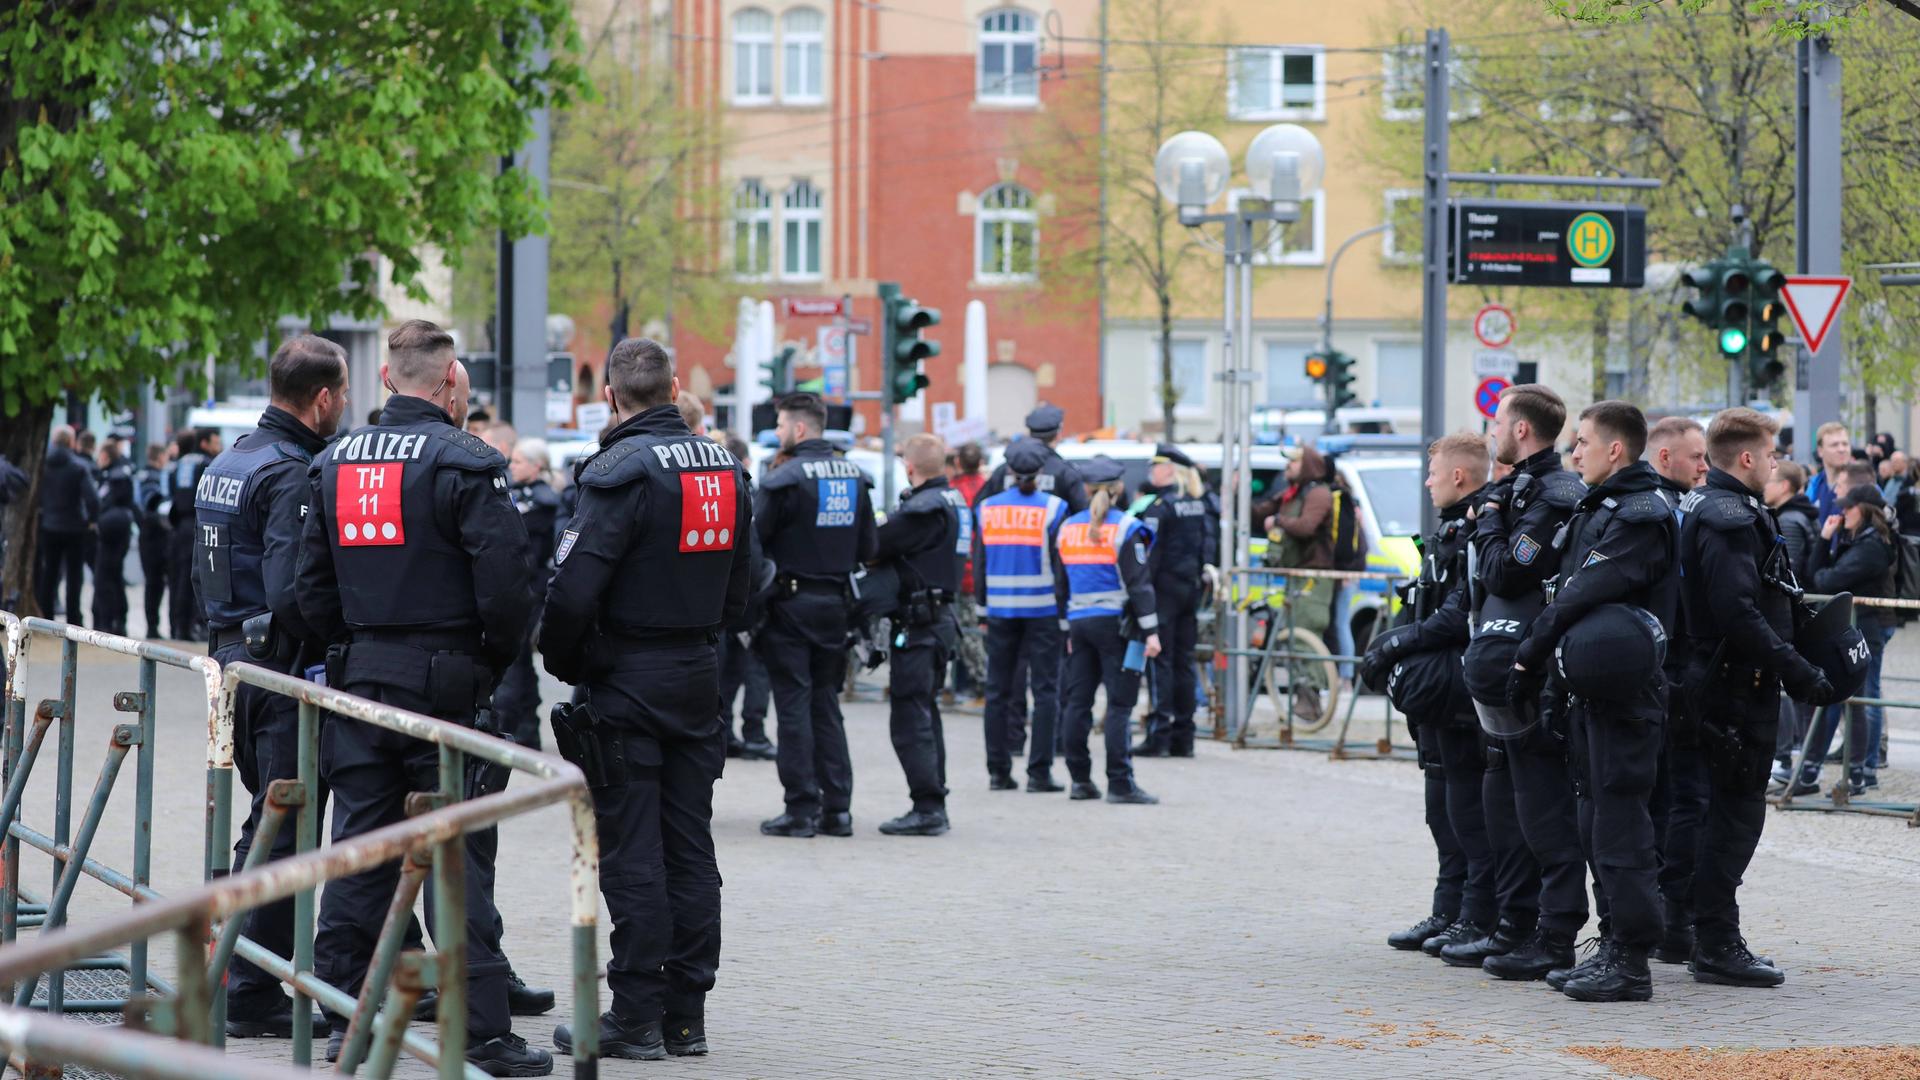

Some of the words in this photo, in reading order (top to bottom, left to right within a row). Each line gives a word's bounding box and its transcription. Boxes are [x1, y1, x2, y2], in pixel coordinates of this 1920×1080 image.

[332, 433, 427, 461] POLIZEI
[652, 440, 735, 469] POLIZEI
[356, 467, 385, 489] TH
[802, 460, 861, 480] POLIZEI
[195, 474, 244, 508] POLIZEI
[694, 475, 721, 497] TH
[828, 479, 848, 496] TH
[358, 493, 379, 516] 11
[702, 501, 719, 523] 11
[826, 494, 850, 512] 260
[816, 511, 854, 527] BEDO
[982, 507, 1046, 530] POLIZEI
[203, 525, 218, 547] TH
[208, 550, 215, 572] 1
[1481, 618, 1521, 633] 224
